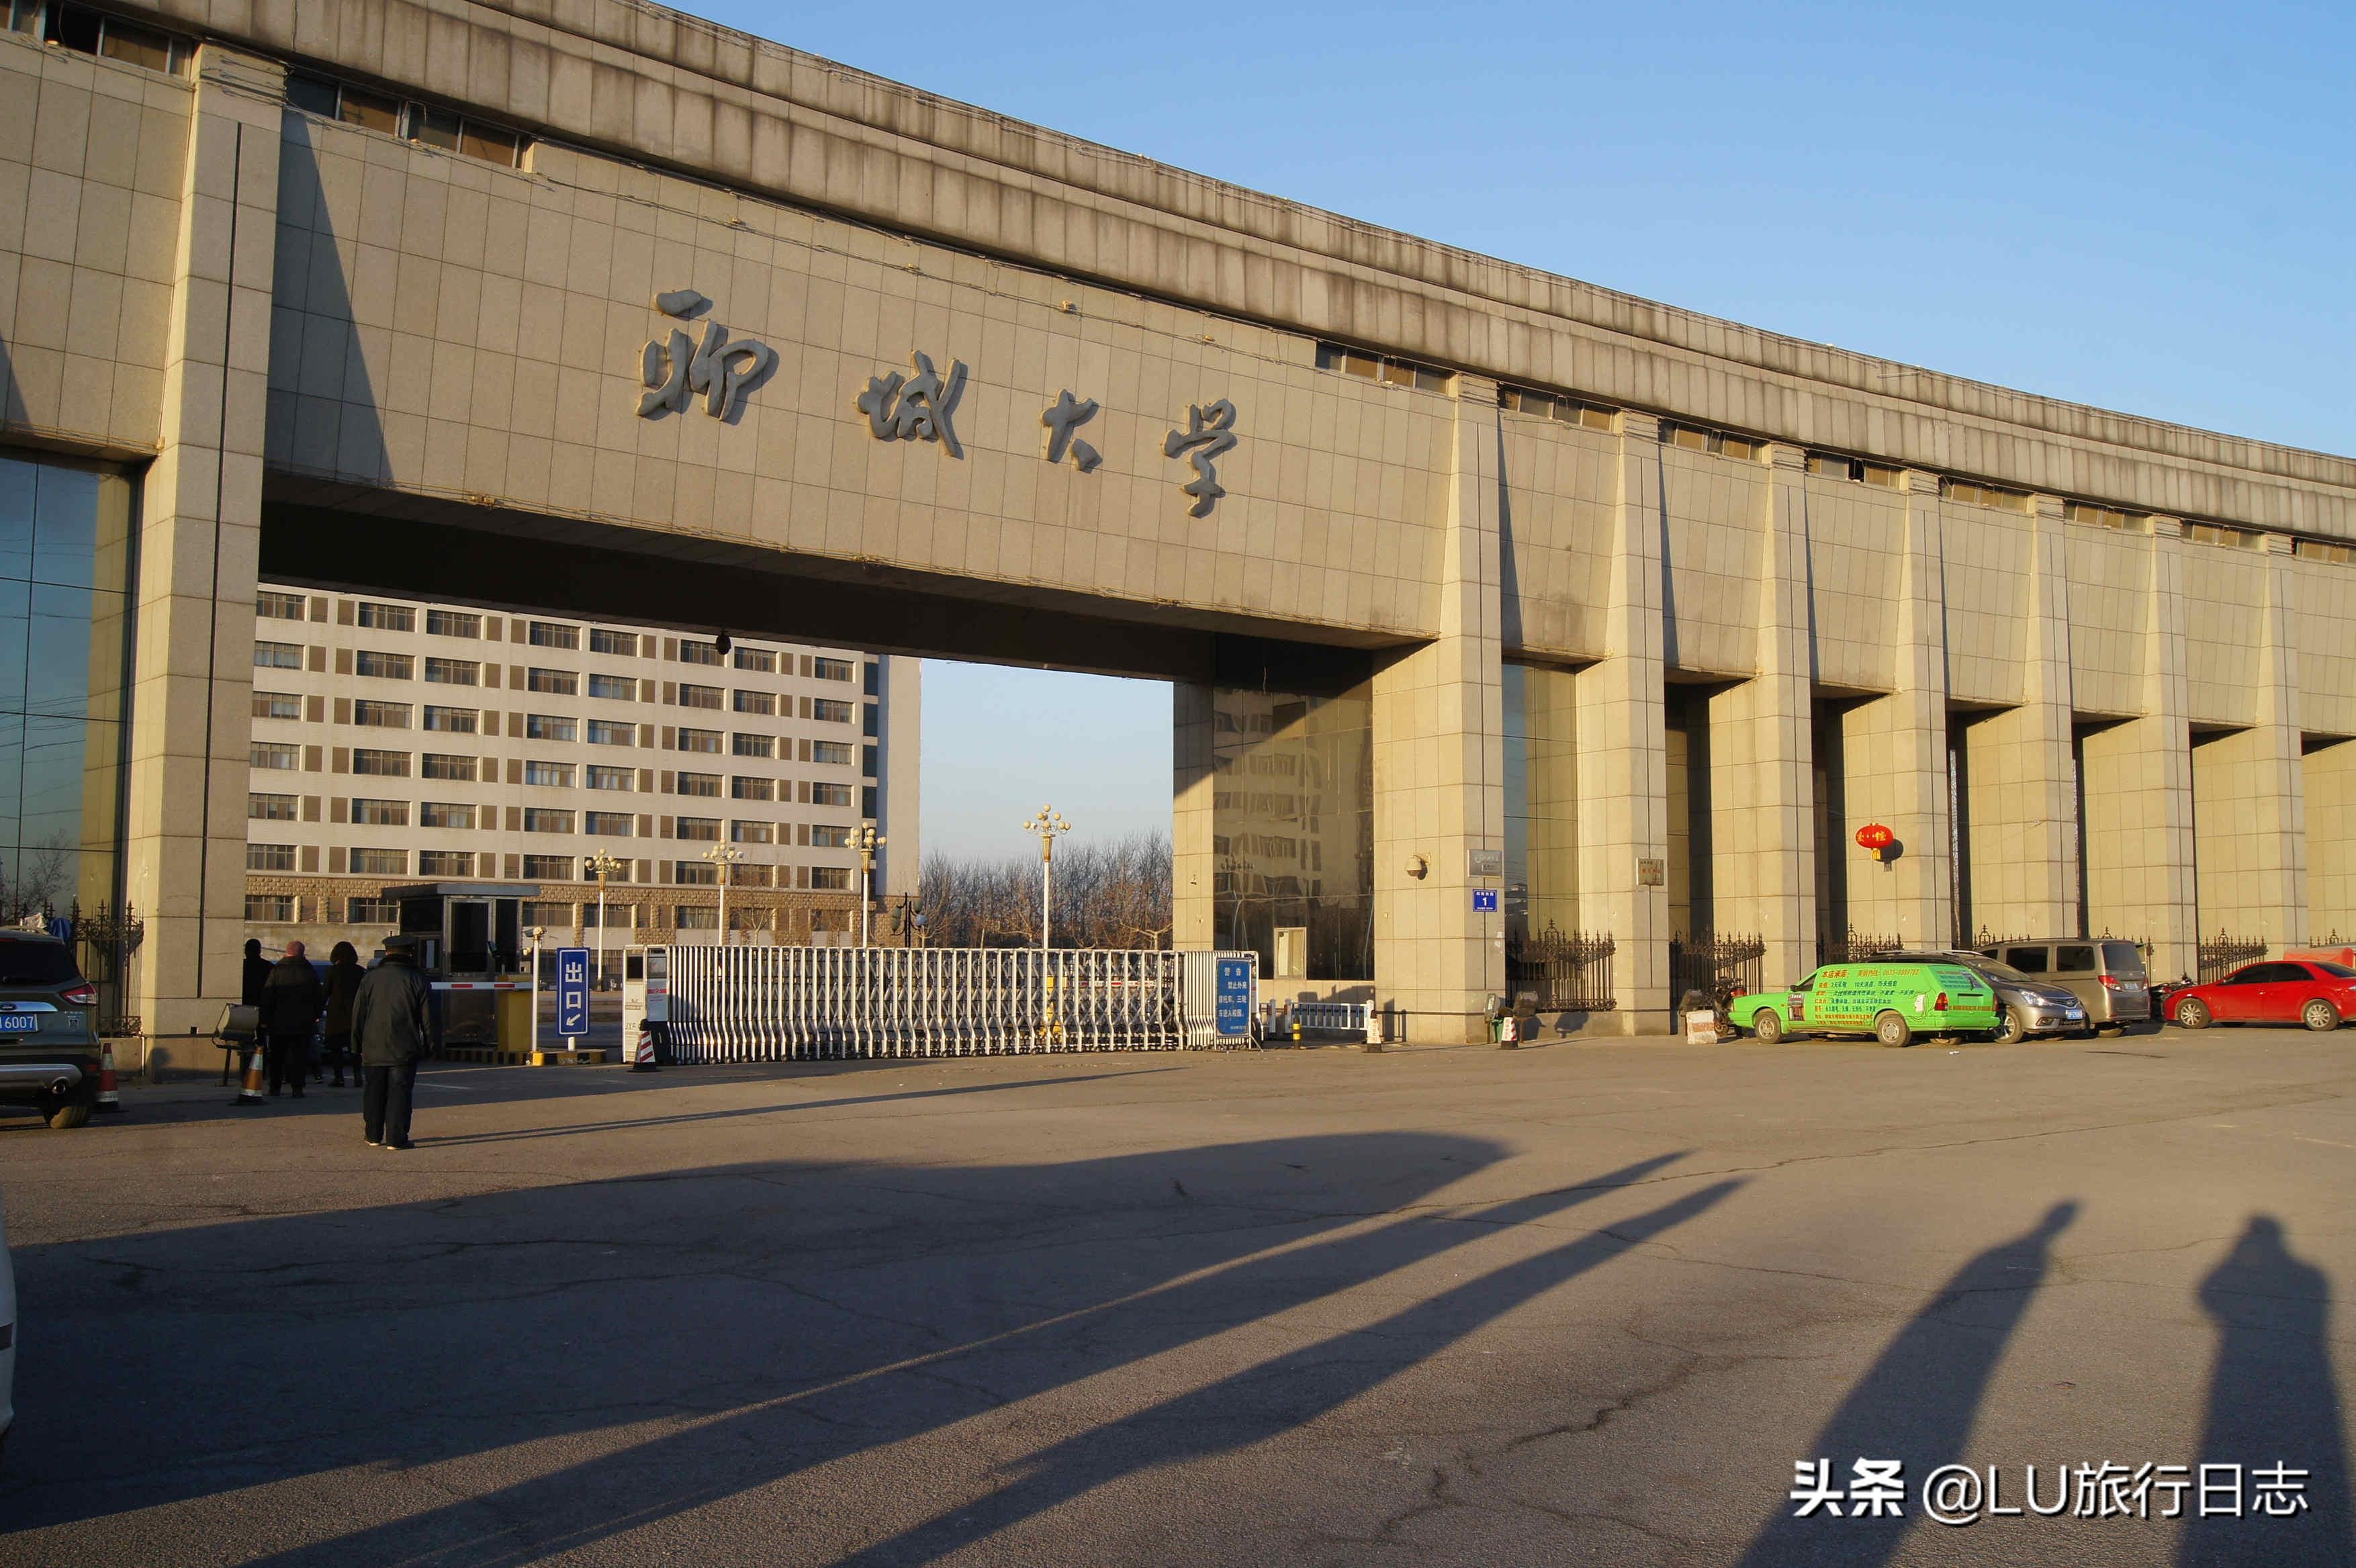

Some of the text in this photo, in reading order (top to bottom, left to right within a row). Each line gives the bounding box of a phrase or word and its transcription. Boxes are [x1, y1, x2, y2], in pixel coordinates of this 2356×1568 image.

[635, 289, 1237, 517] 聊城大学
[1482, 896, 1487, 907] 1
[565, 961, 582, 1009] 出口
[0, 1016, 34, 1029] 6007
